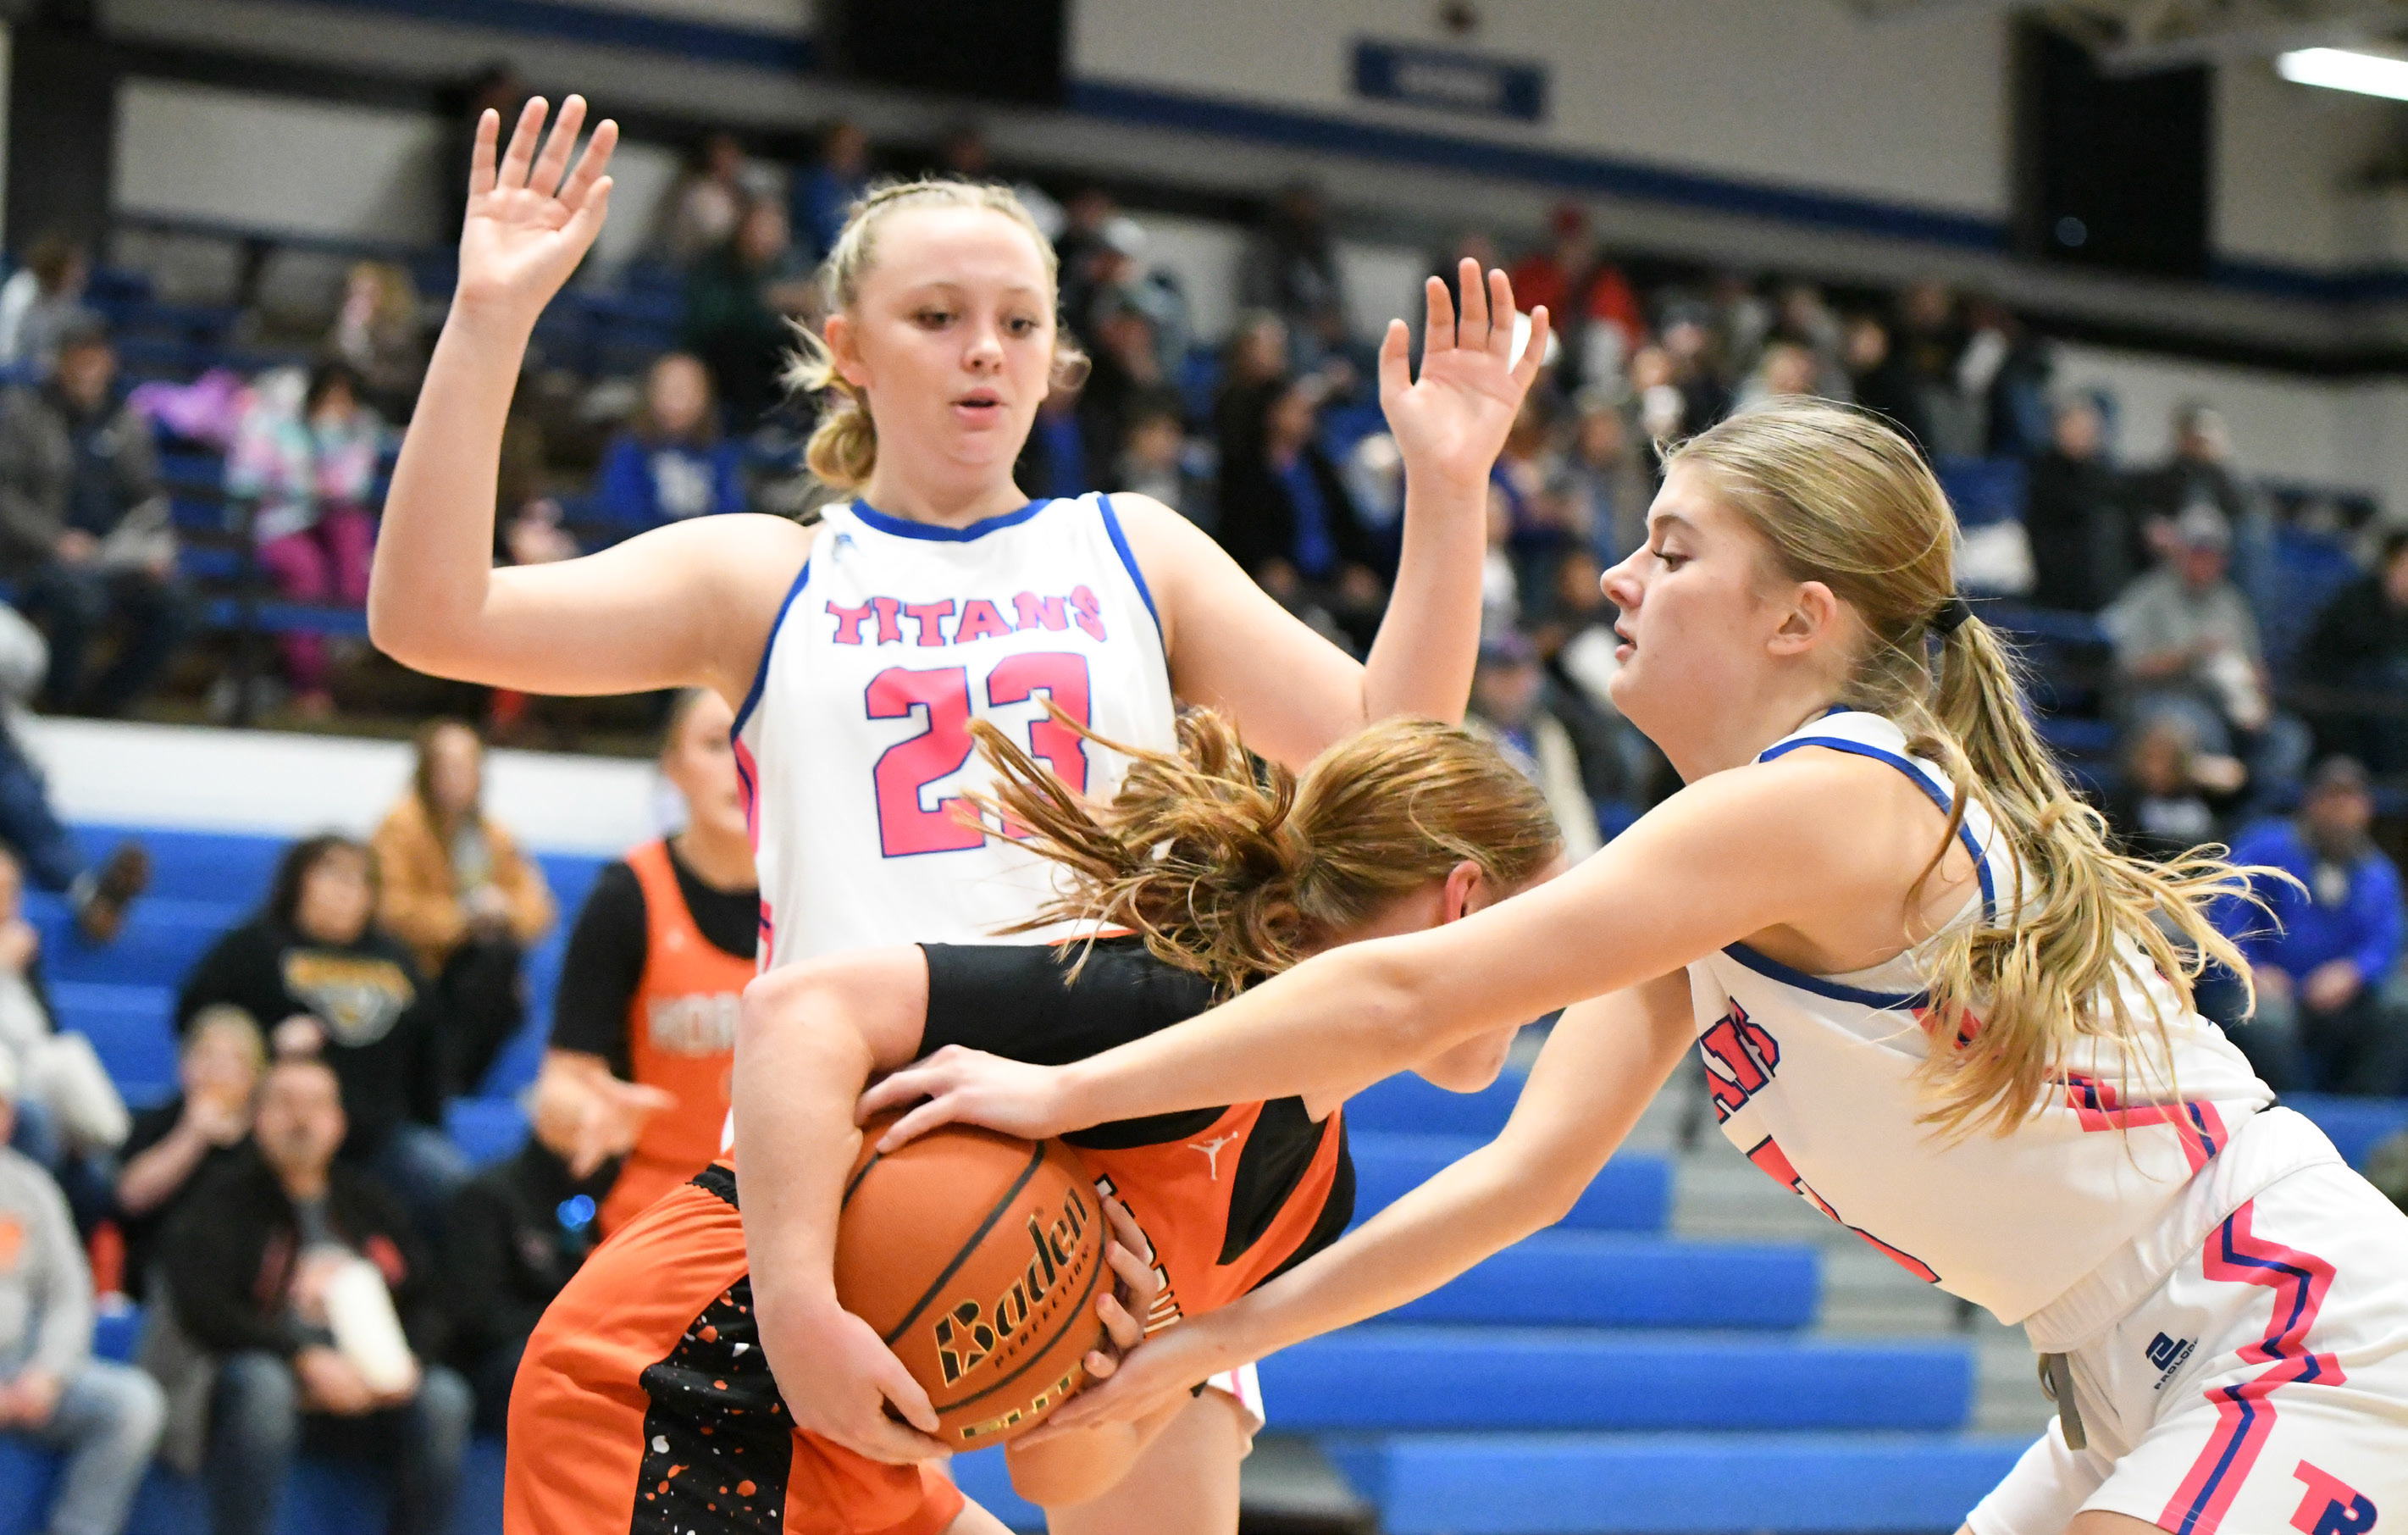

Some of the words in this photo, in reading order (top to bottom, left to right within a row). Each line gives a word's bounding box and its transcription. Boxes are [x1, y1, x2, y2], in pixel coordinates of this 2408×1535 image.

[825, 585, 1107, 646] TITANS
[865, 651, 1092, 859] 23
[933, 1187, 1088, 1388] Baden
